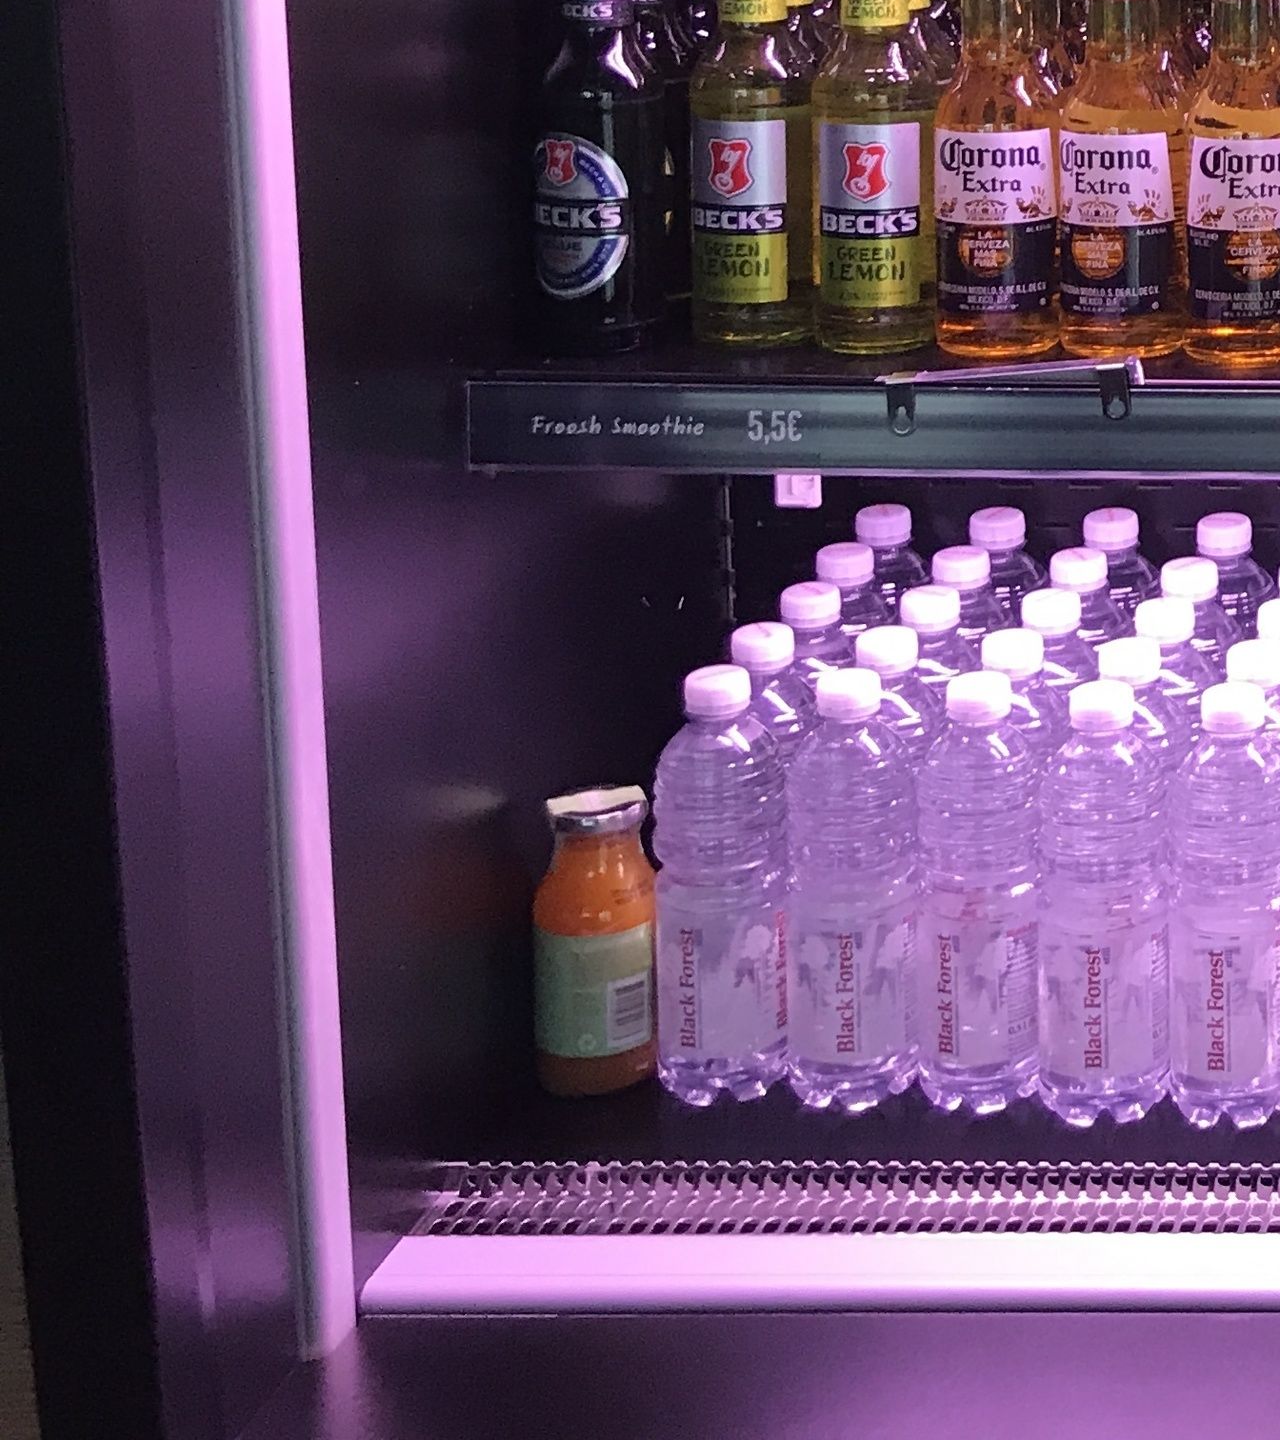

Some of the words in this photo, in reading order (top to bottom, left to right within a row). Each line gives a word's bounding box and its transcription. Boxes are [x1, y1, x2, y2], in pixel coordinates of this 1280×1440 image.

[940, 138, 1041, 176] Corona
[962, 172, 1022, 193] Extra
[1074, 172, 1131, 195] Extra
[822, 210, 918, 234] BECK'S
[828, 261, 905, 282] LEMON
[836, 245, 896, 261] GREEN
[531, 415, 601, 436] Froosh
[611, 417, 705, 436] Smoothie
[748, 410, 803, 444] 5,5€
[679, 928, 695, 988] Forest
[835, 932, 855, 992] Forest
[936, 934, 953, 1004] Forest
[1083, 948, 1101, 1009] Forest
[1206, 949, 1225, 1013] Forest
[679, 991, 697, 1048] Black
[835, 995, 855, 1053] Black
[937, 1007, 953, 1055] Black
[1084, 1014, 1101, 1070] Black
[1207, 1016, 1225, 1072] Black
